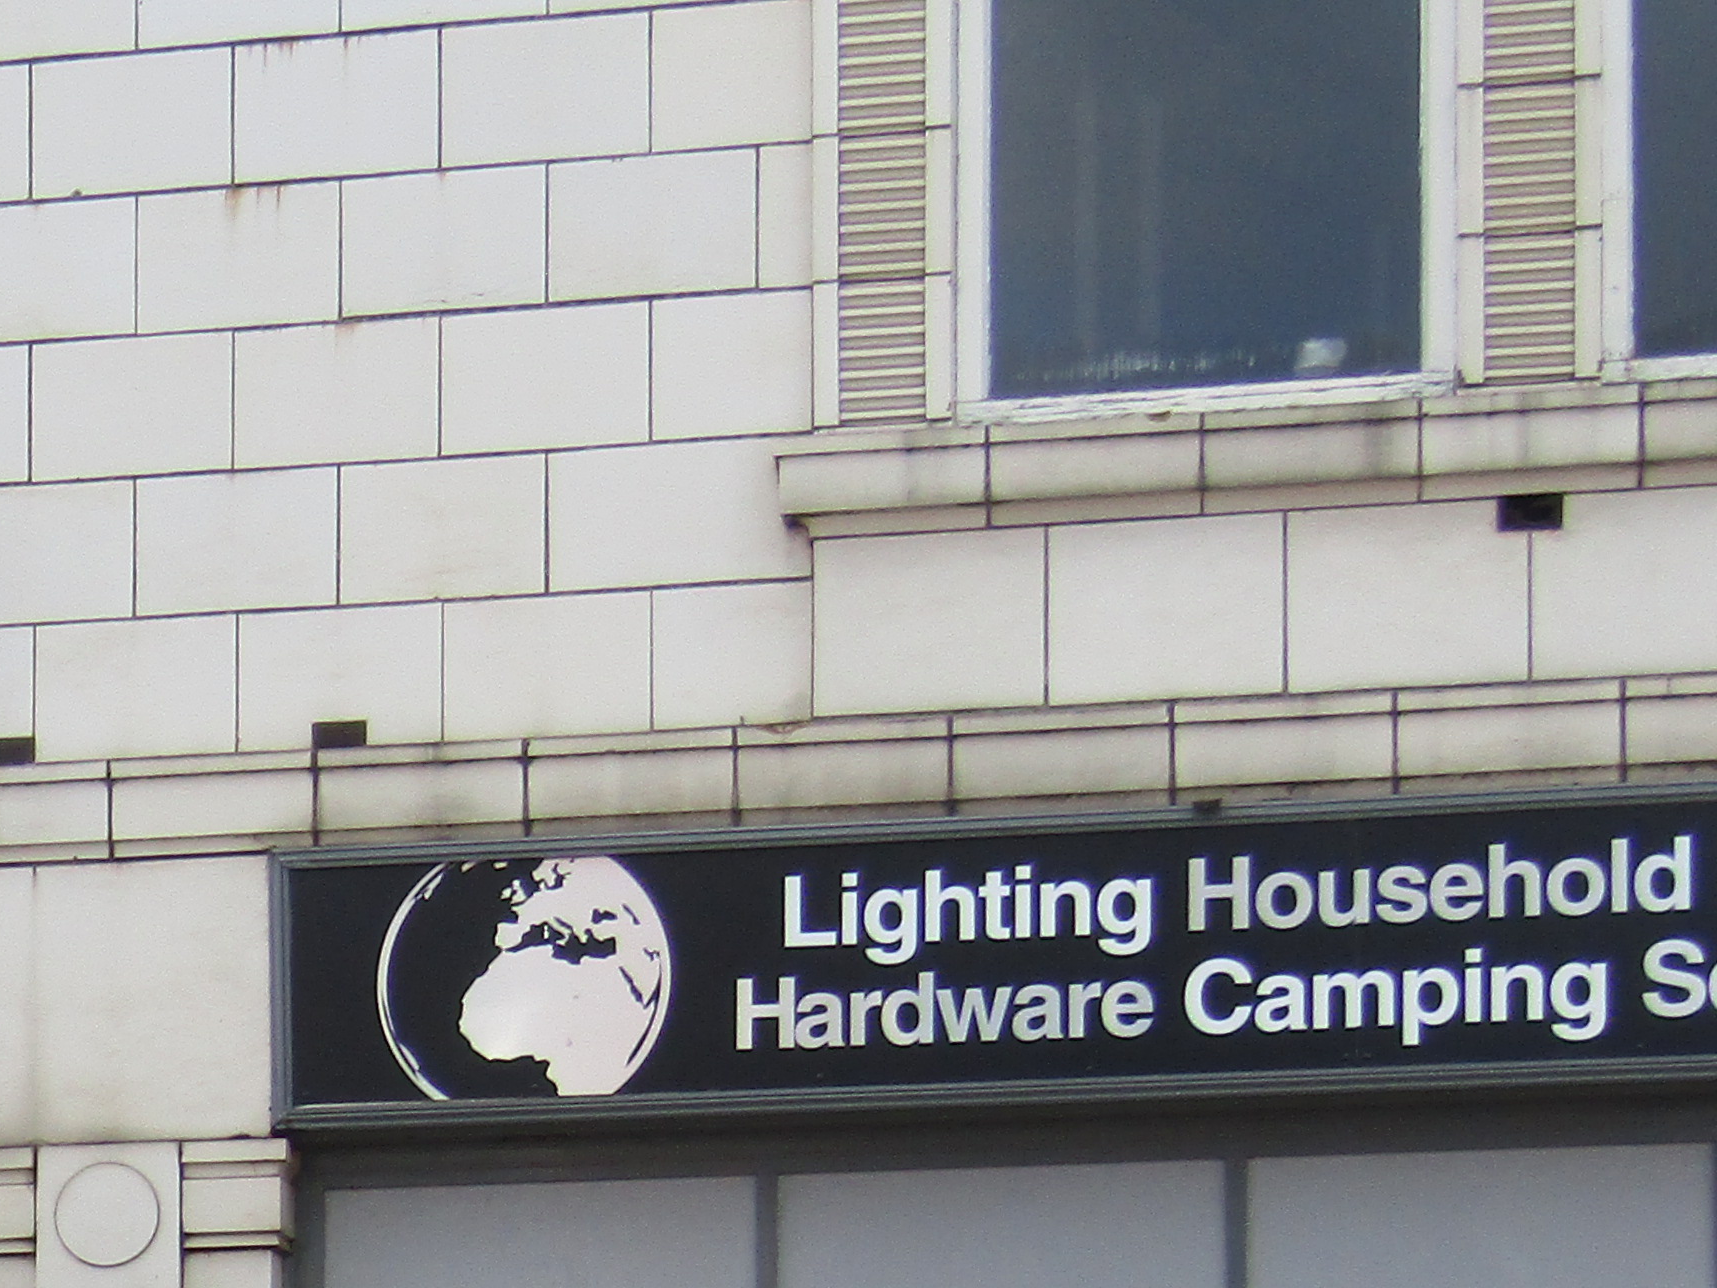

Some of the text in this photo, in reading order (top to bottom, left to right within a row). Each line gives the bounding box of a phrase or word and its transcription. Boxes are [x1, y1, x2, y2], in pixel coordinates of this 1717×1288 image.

[781, 839, 1690, 965] Lighting Household
[734, 939, 1717, 1052] Hardware Camping S
